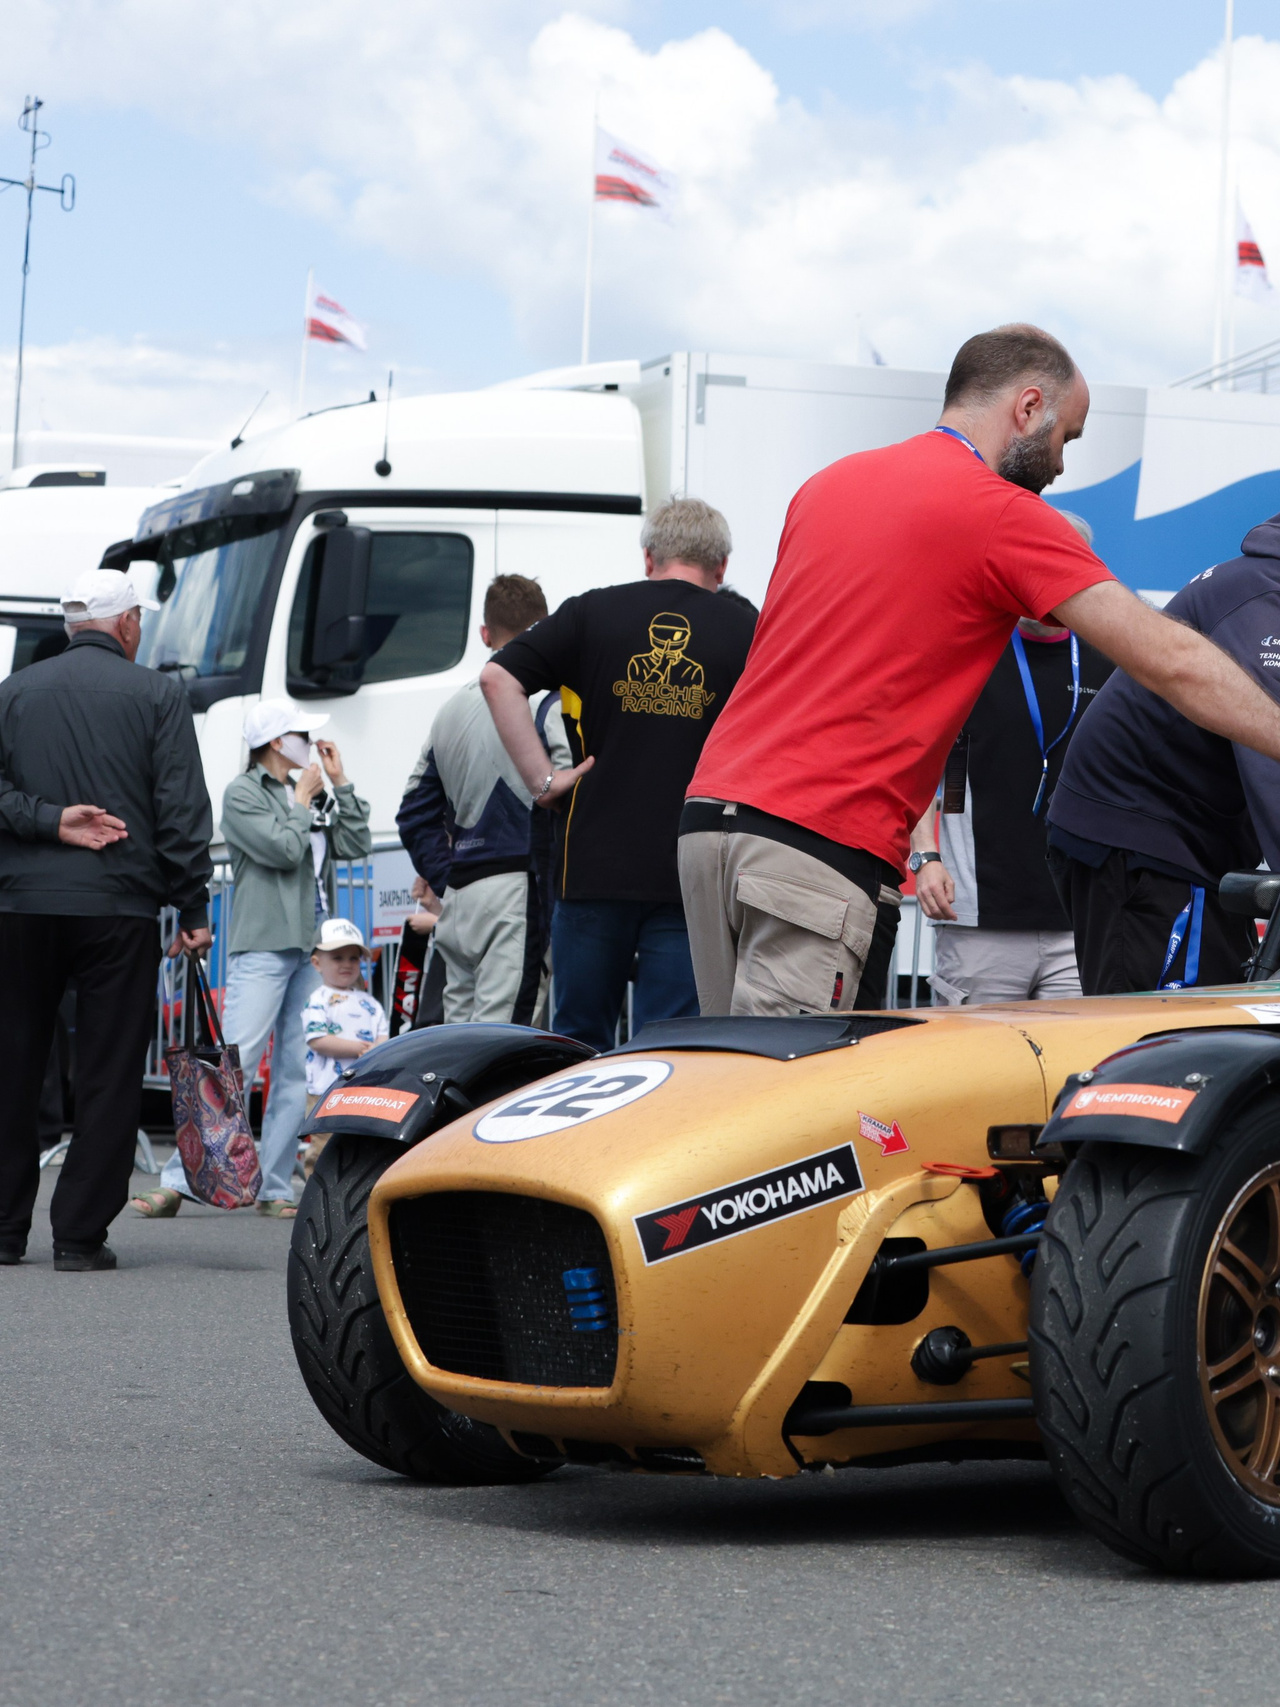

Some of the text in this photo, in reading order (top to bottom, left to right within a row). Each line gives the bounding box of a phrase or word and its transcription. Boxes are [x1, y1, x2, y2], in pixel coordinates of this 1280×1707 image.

[622, 696, 703, 719] RACING
[341, 1095, 407, 1110] ЧЕМПИОНАТ
[490, 1075, 648, 1118] 22
[1095, 1092, 1182, 1109] ЧЕМПИОНАТ
[861, 1115, 892, 1135] KRAMAR
[701, 1162, 845, 1230] YOKOHAMA
